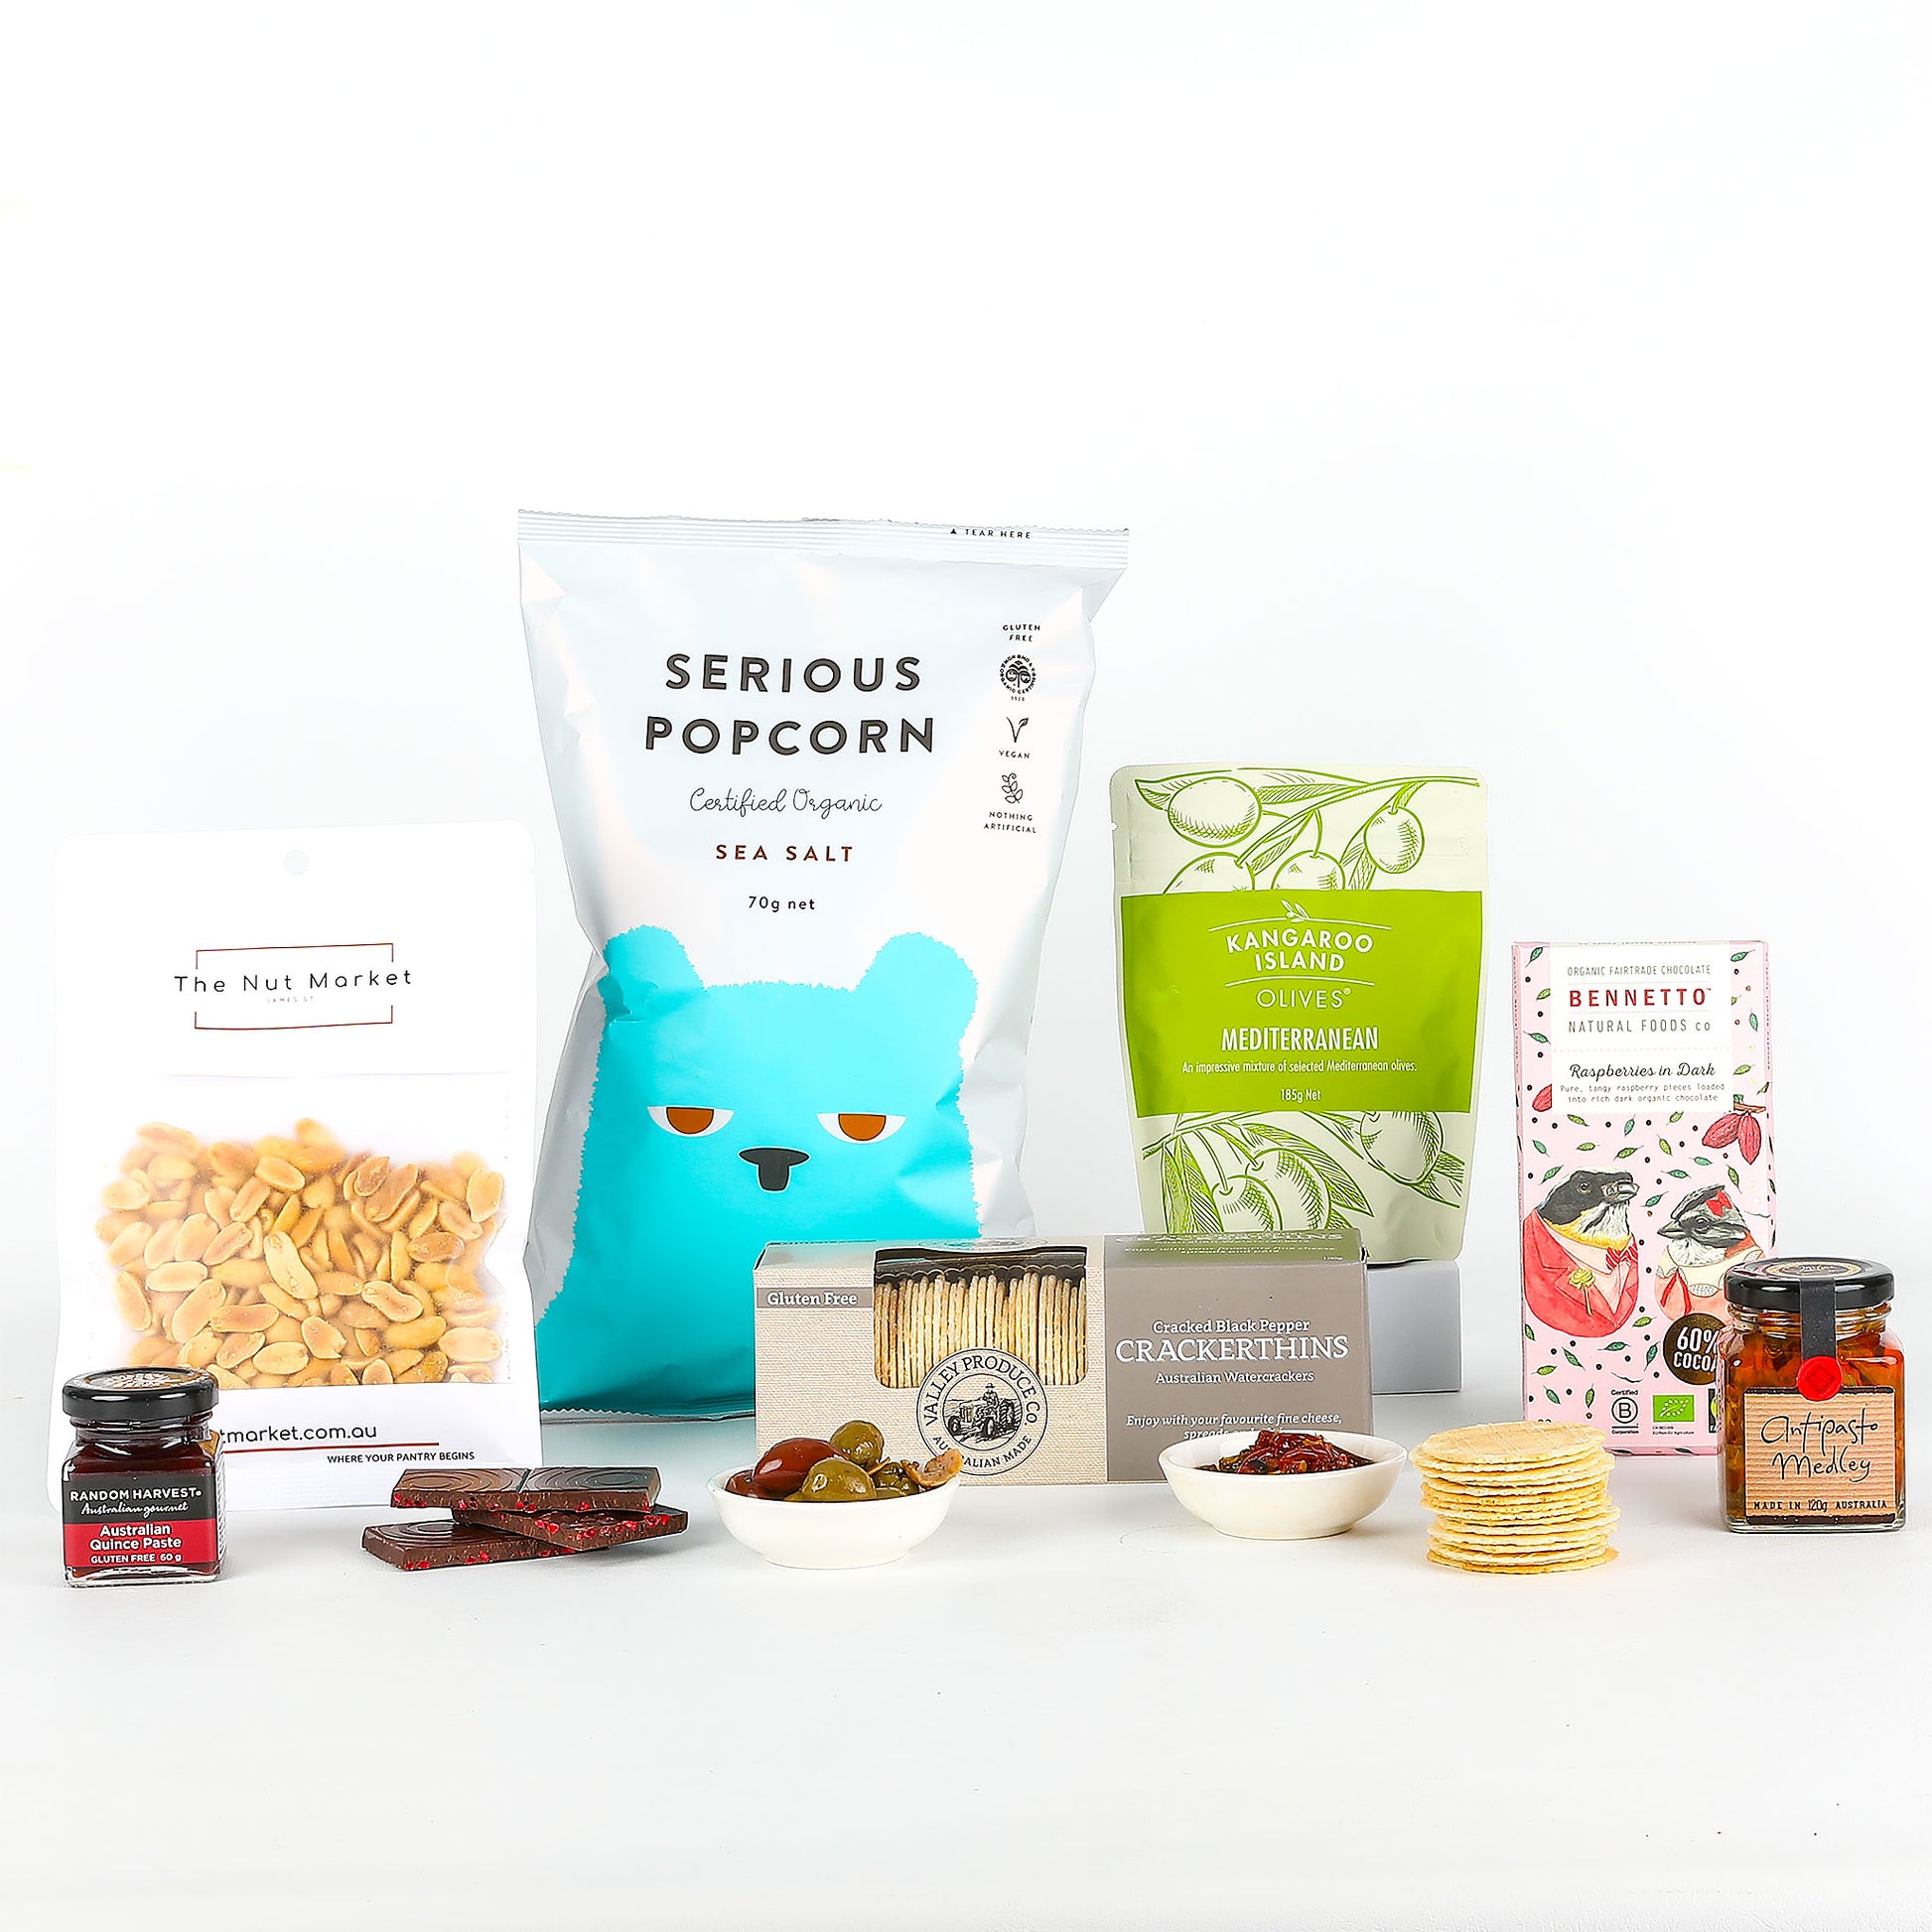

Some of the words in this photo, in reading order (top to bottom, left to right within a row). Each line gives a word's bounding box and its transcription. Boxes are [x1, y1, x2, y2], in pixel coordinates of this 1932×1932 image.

[965, 528, 994, 537] TEAR
[1000, 530, 1031, 539] HERE
[665, 653, 920, 693] SERIOUS
[645, 716, 933, 756] POPCORN
[999, 750, 1031, 759] VEGAN
[689, 787, 786, 817] Certified
[792, 787, 883, 819] Organic
[989, 811, 1034, 821] NOTHING
[983, 823, 1036, 834] ARTIFICIAL
[716, 845, 767, 860] SEA
[785, 846, 852, 862] SALT
[749, 897, 779, 912] 70g
[787, 898, 815, 910] net
[1226, 928, 1374, 954] KANGAROO
[1255, 950, 1345, 972] ISLAND
[1568, 966, 1605, 976] ORGANIC
[1609, 965, 1657, 975] FAIRTRADE
[1661, 964, 1712, 975] CHOCOLATE
[174, 976, 225, 993] The
[243, 974, 292, 991] Nut
[310, 969, 412, 989] Market
[1569, 1020, 1633, 1034] NATURAL
[1641, 1019, 1687, 1032] FOODS
[1695, 1022, 1711, 1032] co
[1221, 1027, 1379, 1051] MEDITERRANEAN
[1182, 1061, 1193, 1073] An
[1195, 1060, 1240, 1075] impressive
[1243, 1060, 1276, 1073] mixture
[1278, 1059, 1288, 1072] of
[1289, 1059, 1324, 1073] selected
[1326, 1059, 1388, 1072] Mediterranean
[1391, 1058, 1418, 1071] olives.
[1570, 1063, 1655, 1081] Raspberries
[1658, 1065, 1673, 1076] in
[1677, 1062, 1717, 1076] Dark
[1281, 1089, 1304, 1103] 185g
[1306, 1089, 1321, 1101] Net
[1588, 1084, 1611, 1093] tangy
[1616, 1083, 1659, 1093] raspberry
[1568, 1095, 1587, 1104] into
[1590, 1094, 1610, 1103] rich
[1638, 1094, 1671, 1104] organic
[1675, 1093, 1719, 1102] chocolate
[766, 1292, 821, 1306] Gluten
[823, 1292, 858, 1306] Free
[1153, 1319, 1213, 1334] Cracked
[1215, 1319, 1256, 1333] Black
[1259, 1318, 1311, 1335] Pepper
[1677, 1325, 1720, 1354] 60%
[1114, 1335, 1349, 1363] CRACKERTHINS
[1156, 1372, 1221, 1384] Australian
[1224, 1370, 1315, 1383] Watercrackers
[923, 1361, 960, 1427] VALLEY
[961, 1355, 1036, 1399] PRODUCE
[1618, 1402, 1632, 1419] B
[1126, 1415, 1160, 1428] Enjoy
[1162, 1414, 1188, 1426] with
[1190, 1416, 1219, 1428] your
[1219, 1413, 1275, 1428] favourite
[1276, 1413, 1300, 1428] fine
[1303, 1412, 1343, 1426] cheese,
[1003, 1435, 1032, 1461] MADE
[327, 1454, 363, 1463] WHERE
[366, 1453, 394, 1462] YOUR
[396, 1452, 436, 1462] PANTRY
[440, 1451, 475, 1460] BEGINS
[1772, 1446, 1871, 1483] Medley
[69, 1489, 129, 1502] RANDOM
[80, 1502, 142, 1515] Australian
[142, 1500, 189, 1518] gourmet
[1753, 1499, 1783, 1509] MADE
[1789, 1499, 1801, 1509] IN
[1808, 1496, 1828, 1512] 120g
[1836, 1498, 1887, 1509] AUSTRALIA
[99, 1523, 171, 1537] Australian
[89, 1539, 139, 1551] Quince
[142, 1537, 182, 1549] Paste
[90, 1555, 129, 1564] GLUTEN
[130, 1554, 156, 1563] FREE
[160, 1553, 174, 1562] 60
